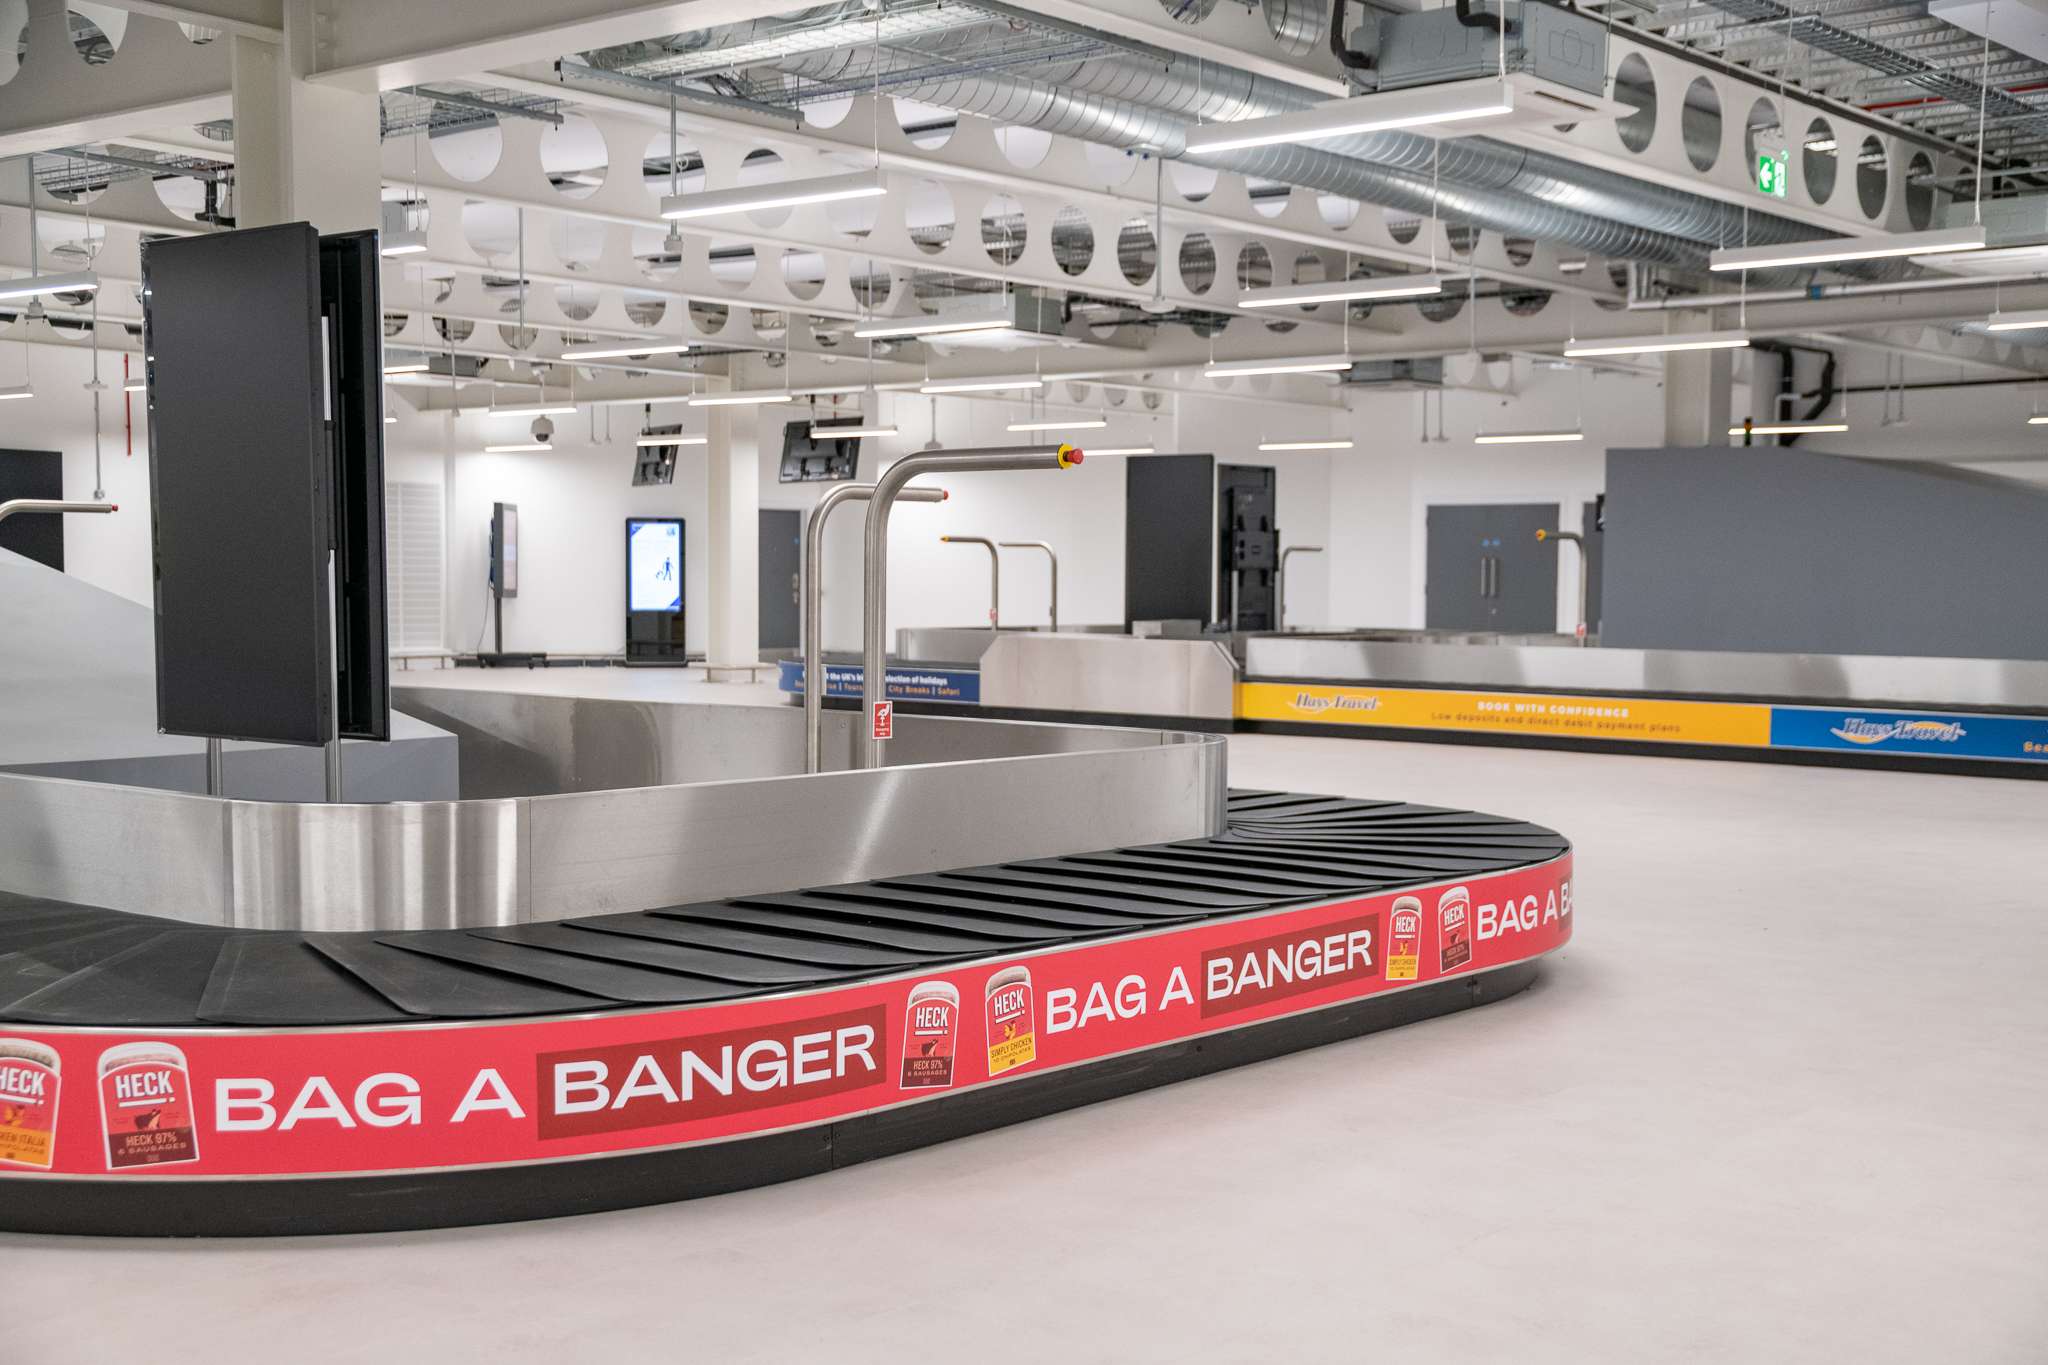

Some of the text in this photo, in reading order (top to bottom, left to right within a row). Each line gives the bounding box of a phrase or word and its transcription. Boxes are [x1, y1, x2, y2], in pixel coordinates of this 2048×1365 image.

[1477, 701, 1630, 718] BOOK WITH CONFIDENCE
[1504, 715, 1523, 725] and
[1395, 915, 1416, 933] HECK
[1443, 903, 1465, 926] HECK
[1477, 894, 1538, 941] BAG
[1543, 889, 1558, 926] A
[1046, 929, 1373, 1035] BAG A BANGER
[994, 988, 1025, 1016] HECK
[915, 1007, 949, 1028] HECK
[914, 1060, 930, 1070] HECK
[0, 1067, 46, 1096] HECK
[114, 1070, 174, 1099] HECK
[215, 1023, 877, 1133] BAG A BANGER
[126, 1131, 177, 1147] HECK 97%
[128, 1142, 187, 1154] SAUSAGES
